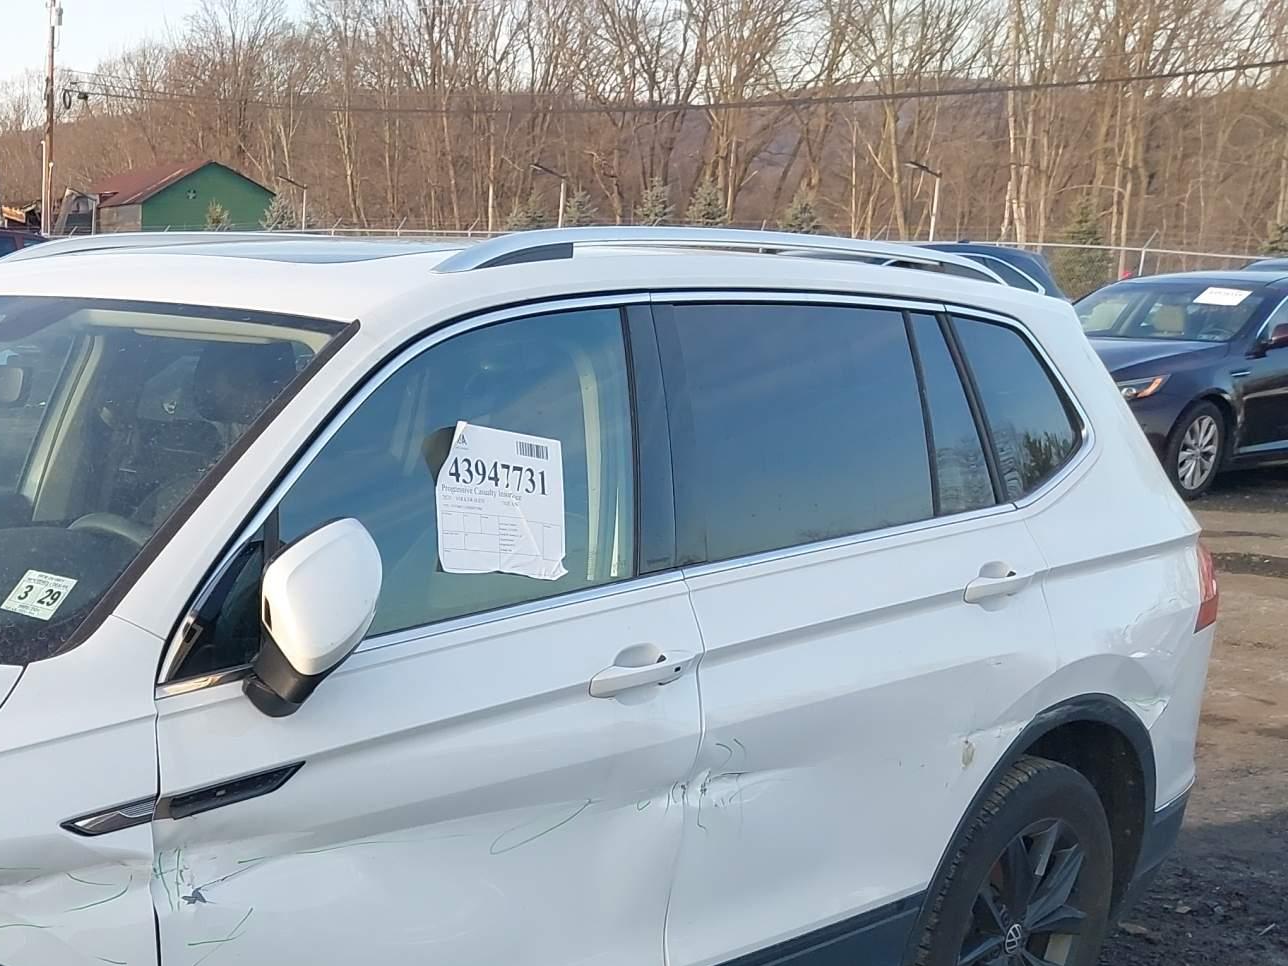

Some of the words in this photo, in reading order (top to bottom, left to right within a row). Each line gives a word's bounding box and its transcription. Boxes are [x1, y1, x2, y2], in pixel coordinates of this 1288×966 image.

[448, 456, 548, 496] 43947731
[17, 584, 34, 601] 3
[37, 588, 62, 607] 29
